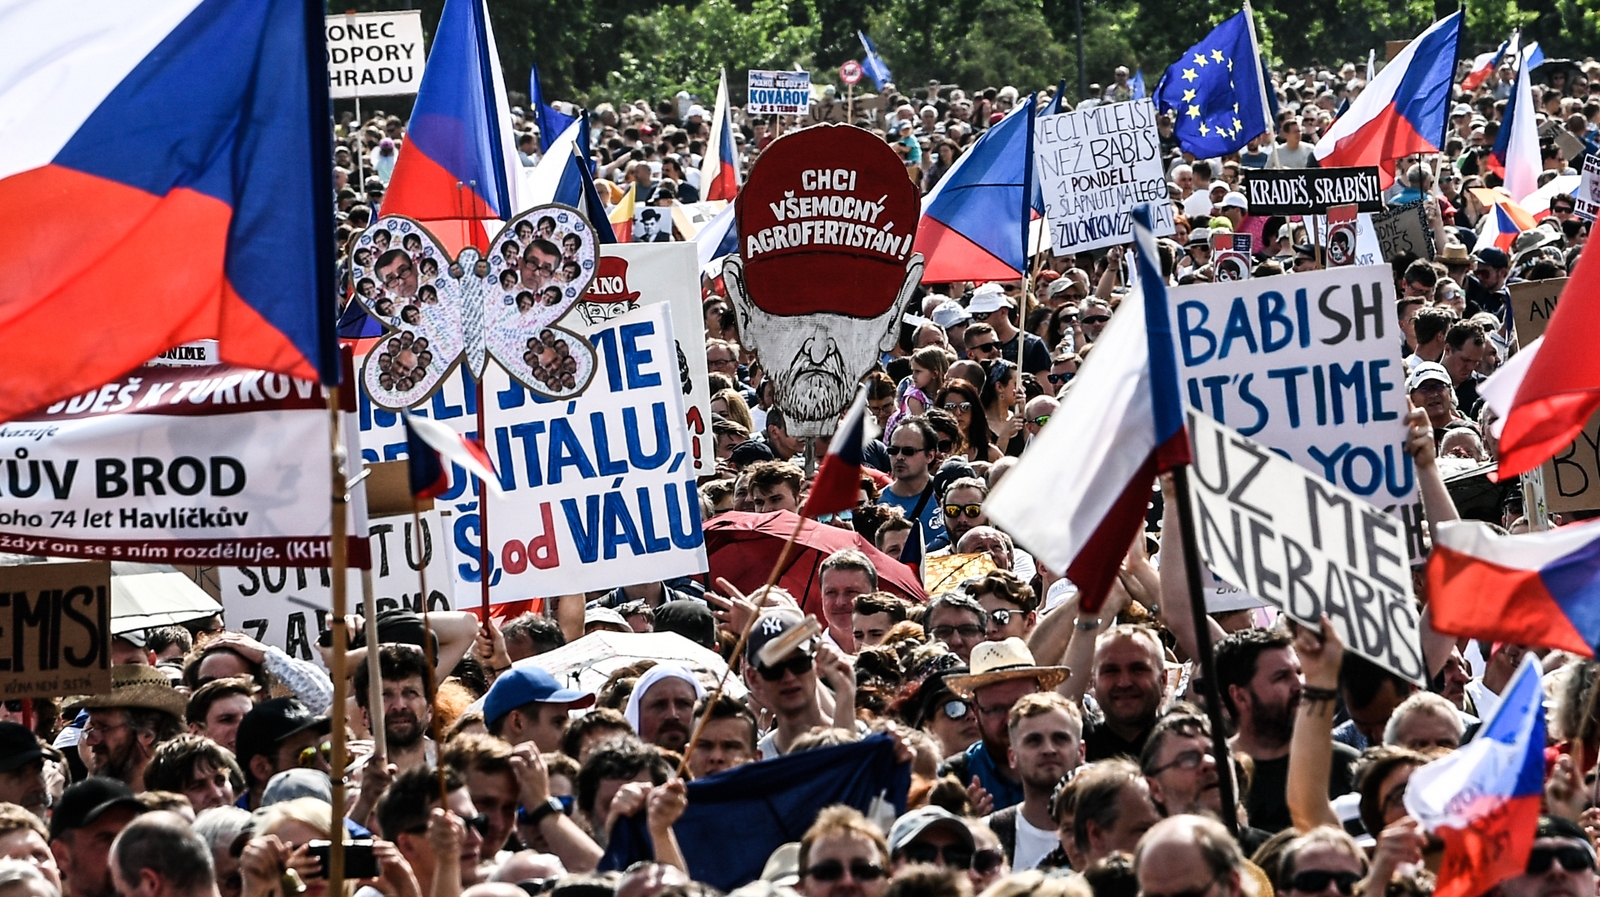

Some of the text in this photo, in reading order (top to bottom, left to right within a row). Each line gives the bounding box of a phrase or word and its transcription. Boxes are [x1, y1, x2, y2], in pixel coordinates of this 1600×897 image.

[325, 22, 395, 42] ONEC
[326, 43, 415, 65] DPORY
[750, 88, 809, 105] KOVÁŘOV
[1040, 141, 1092, 180] NEŽ
[802, 168, 857, 191] CHCI
[1070, 162, 1138, 193] PONDĚLÍ
[1134, 177, 1169, 203] LEGO
[1249, 171, 1380, 208] KRADEŠ, SRABIŠI!
[769, 189, 888, 224] VŠEMOCNÝ
[747, 220, 912, 260] AGROFERTISTÁN!
[586, 276, 624, 295] ANO
[1177, 281, 1385, 367] BABISH
[136, 382, 174, 408] K
[1187, 359, 1398, 437] IT'S TIME
[95, 455, 247, 500] BROD
[1186, 411, 1274, 523] UŽ
[50, 510, 77, 528] 74
[83, 508, 113, 528] let
[120, 506, 249, 528] Havlíčkův
[51, 542, 79, 553] on
[84, 545, 107, 555] se
[112, 546, 122, 556] s
[127, 543, 168, 558] ním
[174, 542, 281, 562] rozděluje.
[501, 502, 560, 575] od
[1197, 489, 1423, 681] NEBABIŠ
